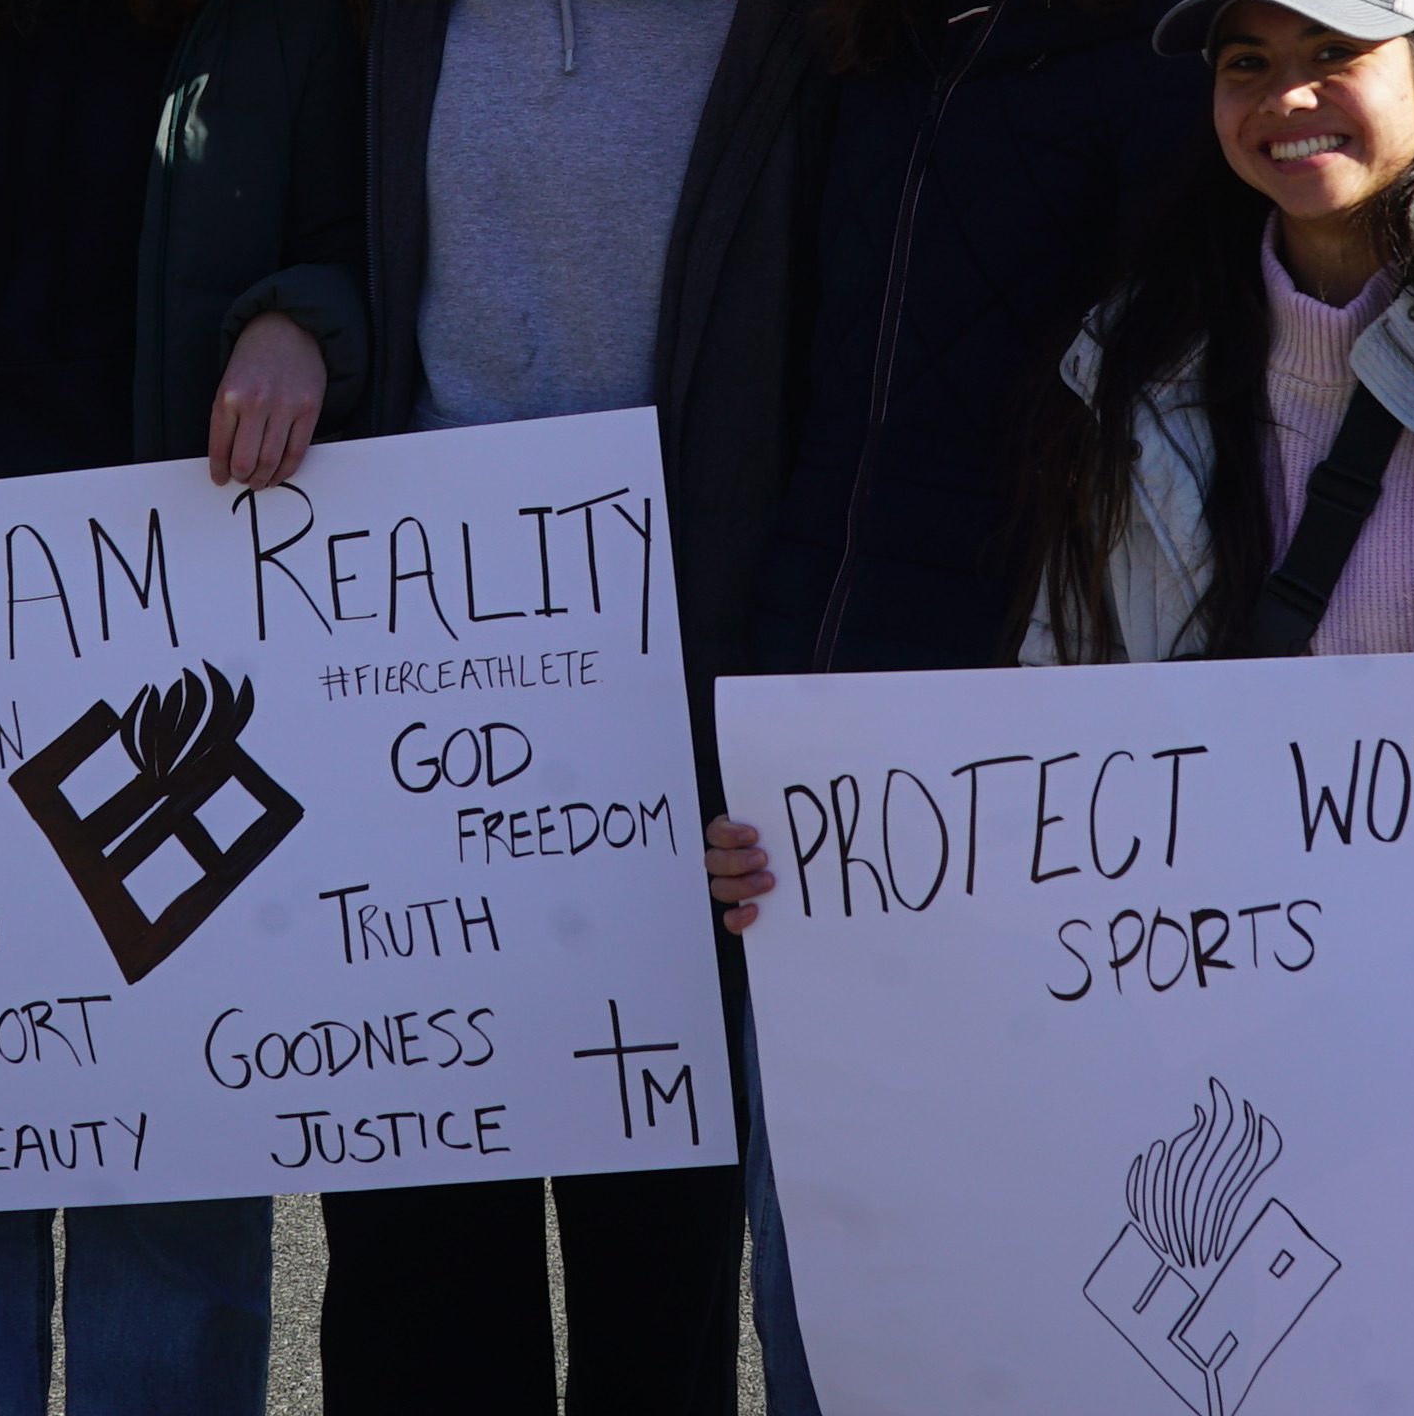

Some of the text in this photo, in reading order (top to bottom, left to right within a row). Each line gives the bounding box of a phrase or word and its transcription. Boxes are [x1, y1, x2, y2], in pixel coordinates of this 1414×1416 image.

[231, 481, 653, 655] REALITY
[318, 650, 600, 702] #FIERCEATHLETE
[390, 721, 533, 794] GOD
[456, 792, 678, 865] FREEDOM
[783, 744, 1208, 918] PROTECT
[318, 883, 501, 965] TRUTH
[1045, 899, 1323, 1002] SPORTS
[204, 1007, 496, 1090] GOODNESS
[270, 1104, 512, 1169] JUSTICE
